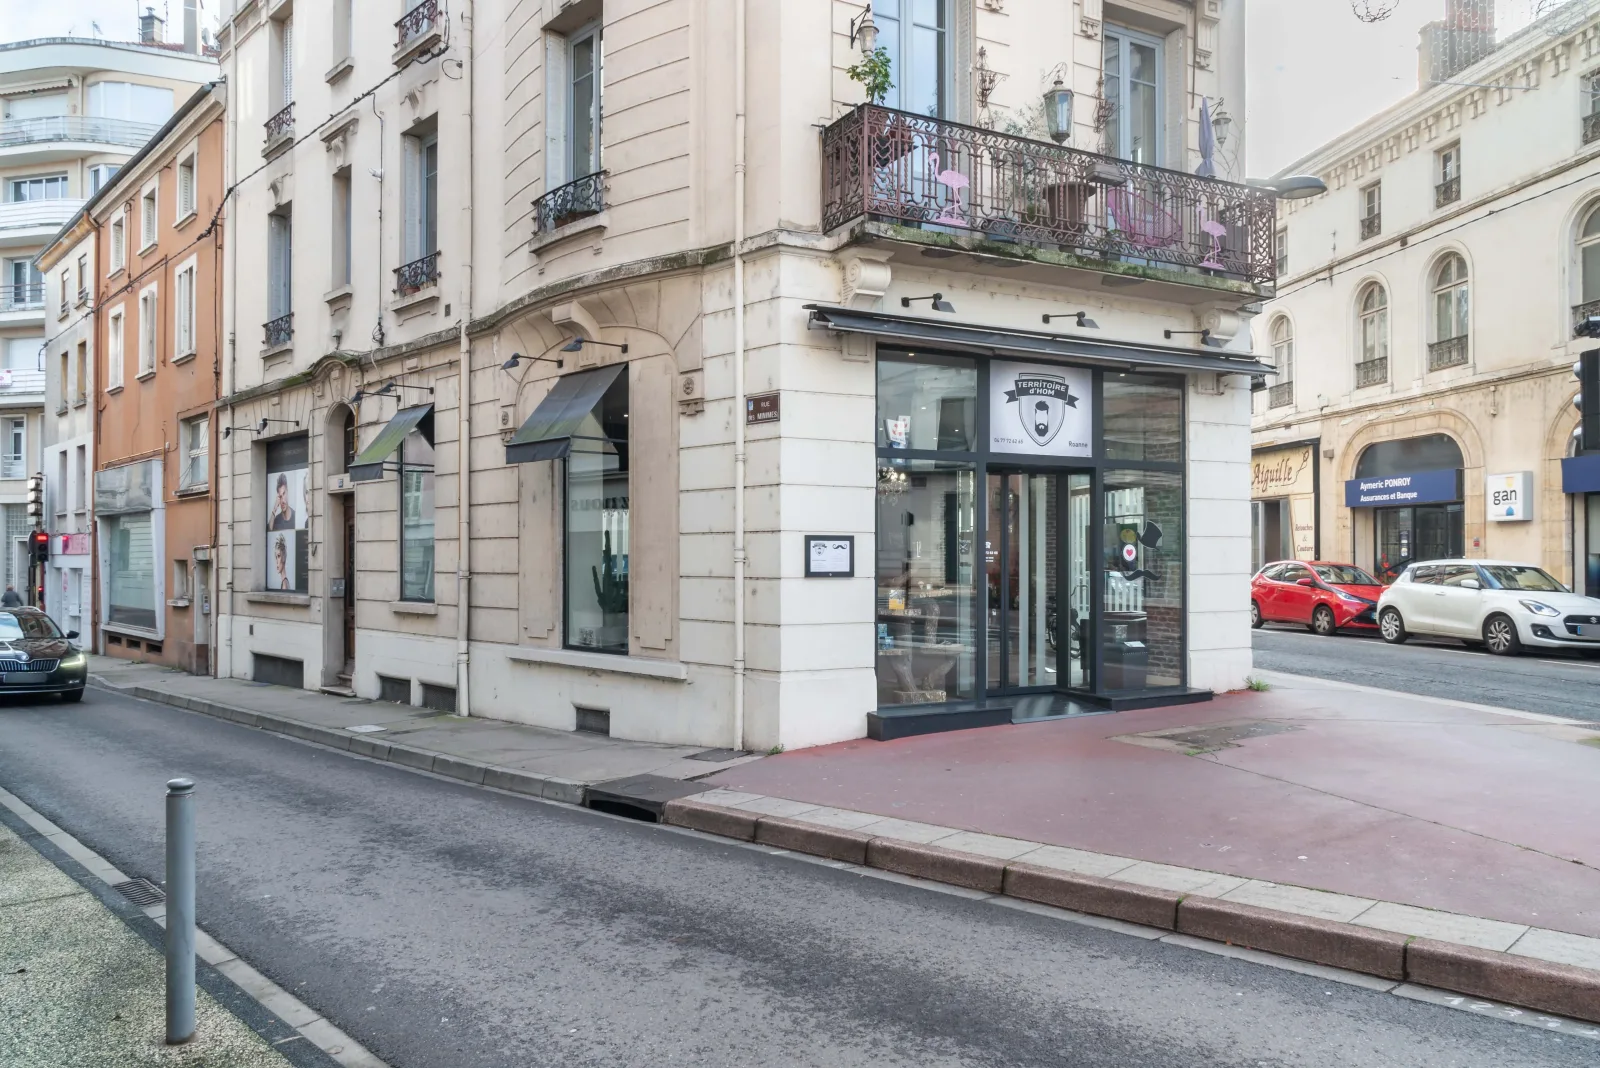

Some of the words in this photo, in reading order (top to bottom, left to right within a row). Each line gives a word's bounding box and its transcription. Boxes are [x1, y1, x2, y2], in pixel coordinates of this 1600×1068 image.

[1029, 387, 1055, 396] d'HOM
[1252, 457, 1293, 492] Aiguille
[1360, 480, 1384, 491] Aymeric
[1384, 477, 1411, 488] PONROY
[1360, 493, 1389, 502] Assurances
[1389, 492, 1396, 500] et
[1396, 491, 1418, 500] Banque
[1493, 490, 1517, 506] gan
[1297, 544, 1314, 553] Couture
